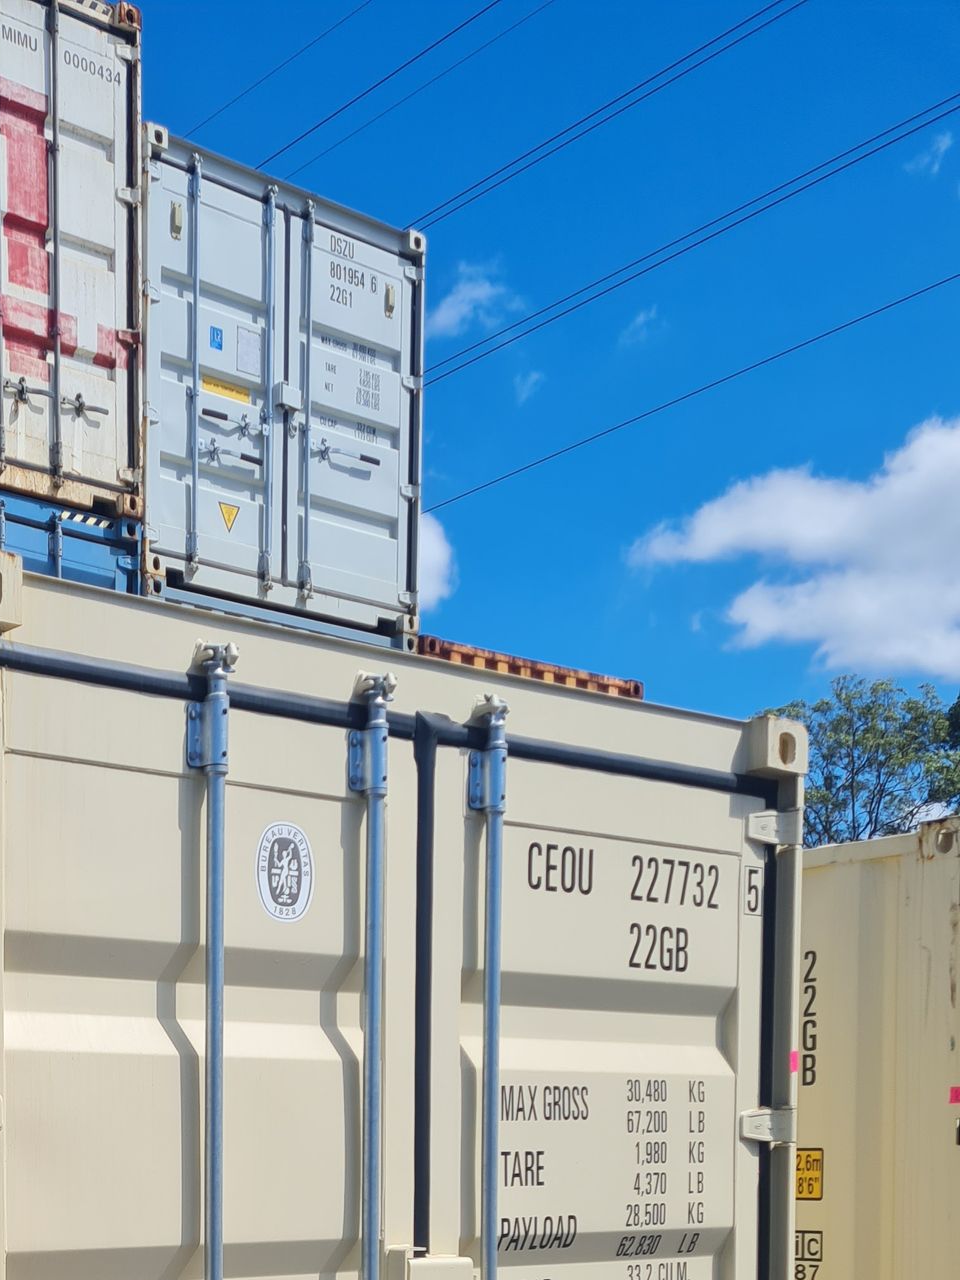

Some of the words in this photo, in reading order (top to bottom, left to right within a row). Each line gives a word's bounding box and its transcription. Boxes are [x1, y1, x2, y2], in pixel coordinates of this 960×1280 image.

[2, 24, 38, 52] MIMU
[64, 50, 122, 86] 0000434
[330, 234, 354, 260] DSZU
[330, 260, 365, 290] 801954
[371, 275, 377, 294] 6
[330, 284, 353, 309] 22G1
[325, 362, 337, 375] TARE
[324, 381, 334, 393] NET
[260, 827, 284, 872] BUREAU
[286, 829, 309, 877] VERITAS
[527, 842, 594, 896] CEOU
[630, 855, 719, 910] 227732
[746, 868, 759, 914] 5
[628, 922, 689, 973] 22GB
[801, 950, 818, 1086] 22GB
[500, 1084, 538, 1122] MAX
[543, 1085, 589, 1121] GROSS
[626, 1079, 667, 1104] 30,480
[688, 1080, 706, 1103] KG
[626, 1110, 668, 1134] 67,200
[689, 1110, 706, 1134] LB
[635, 1141, 668, 1166] 1,980
[688, 1141, 705, 1164] KG
[501, 1150, 545, 1187] TARE
[633, 1172, 667, 1196] 4,370
[688, 1171, 704, 1194] LB
[626, 1203, 666, 1228] 28,500
[687, 1202, 704, 1225] KG
[497, 1214, 578, 1252] PAYLOAD
[616, 1234, 662, 1257] 62,830
[677, 1232, 700, 1254] LB
